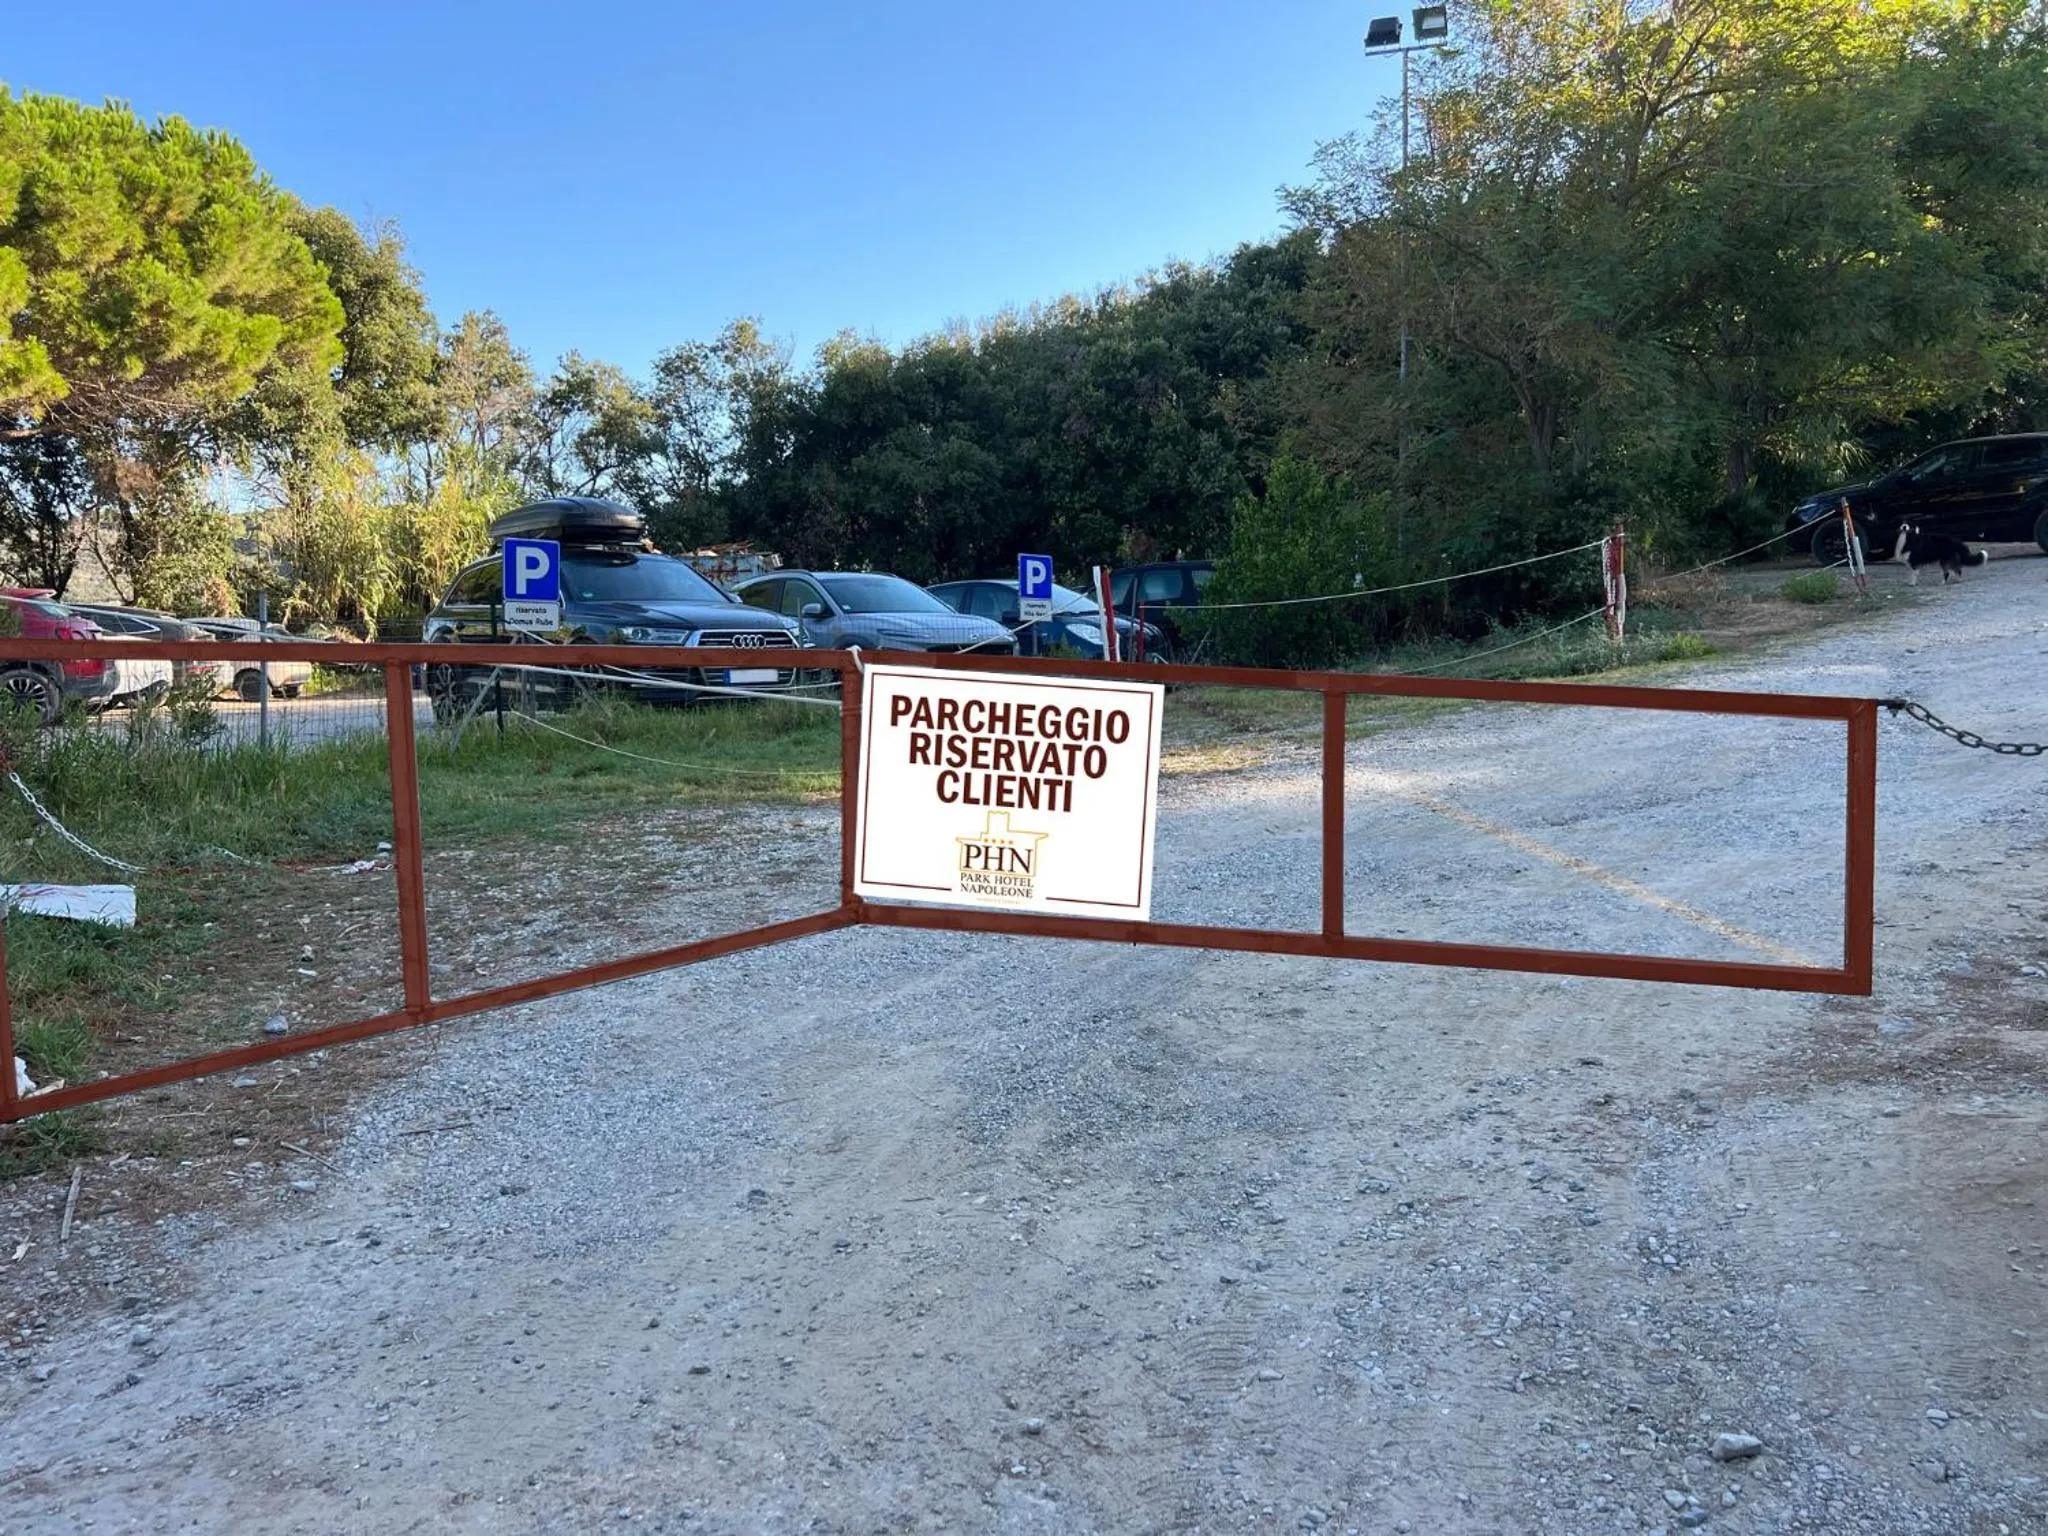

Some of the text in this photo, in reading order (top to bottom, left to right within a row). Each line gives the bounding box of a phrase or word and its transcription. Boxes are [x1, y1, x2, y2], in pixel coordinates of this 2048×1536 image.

[516, 547, 549, 594] P
[1027, 560, 1046, 594] P
[890, 694, 1130, 744] PARCHEGGIO
[909, 732, 1107, 779] RISERVATO
[936, 770, 1072, 812] CLIENTI
[963, 843, 1034, 873] PHN
[960, 872, 1034, 888] PARK HOTEL
[960, 882, 1033, 898] NAPOLEONE
